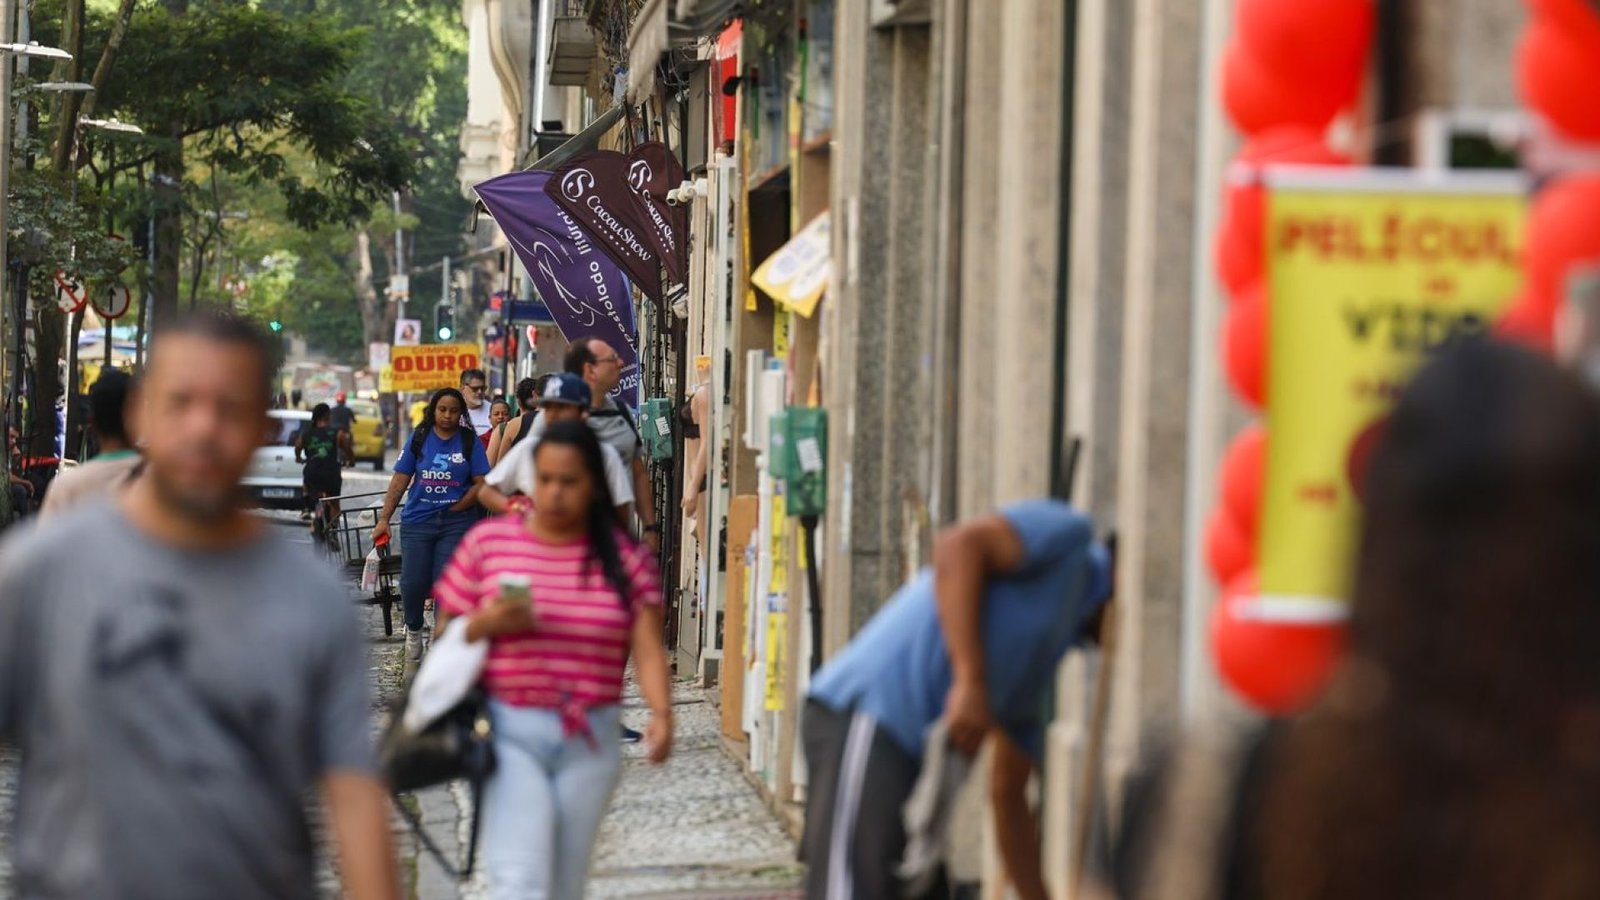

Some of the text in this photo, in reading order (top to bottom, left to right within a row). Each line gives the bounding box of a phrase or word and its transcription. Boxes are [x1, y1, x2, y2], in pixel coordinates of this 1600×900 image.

[587, 195, 651, 261] CacauShow
[394, 354, 477, 372] OURO
[422, 469, 451, 480] anos
